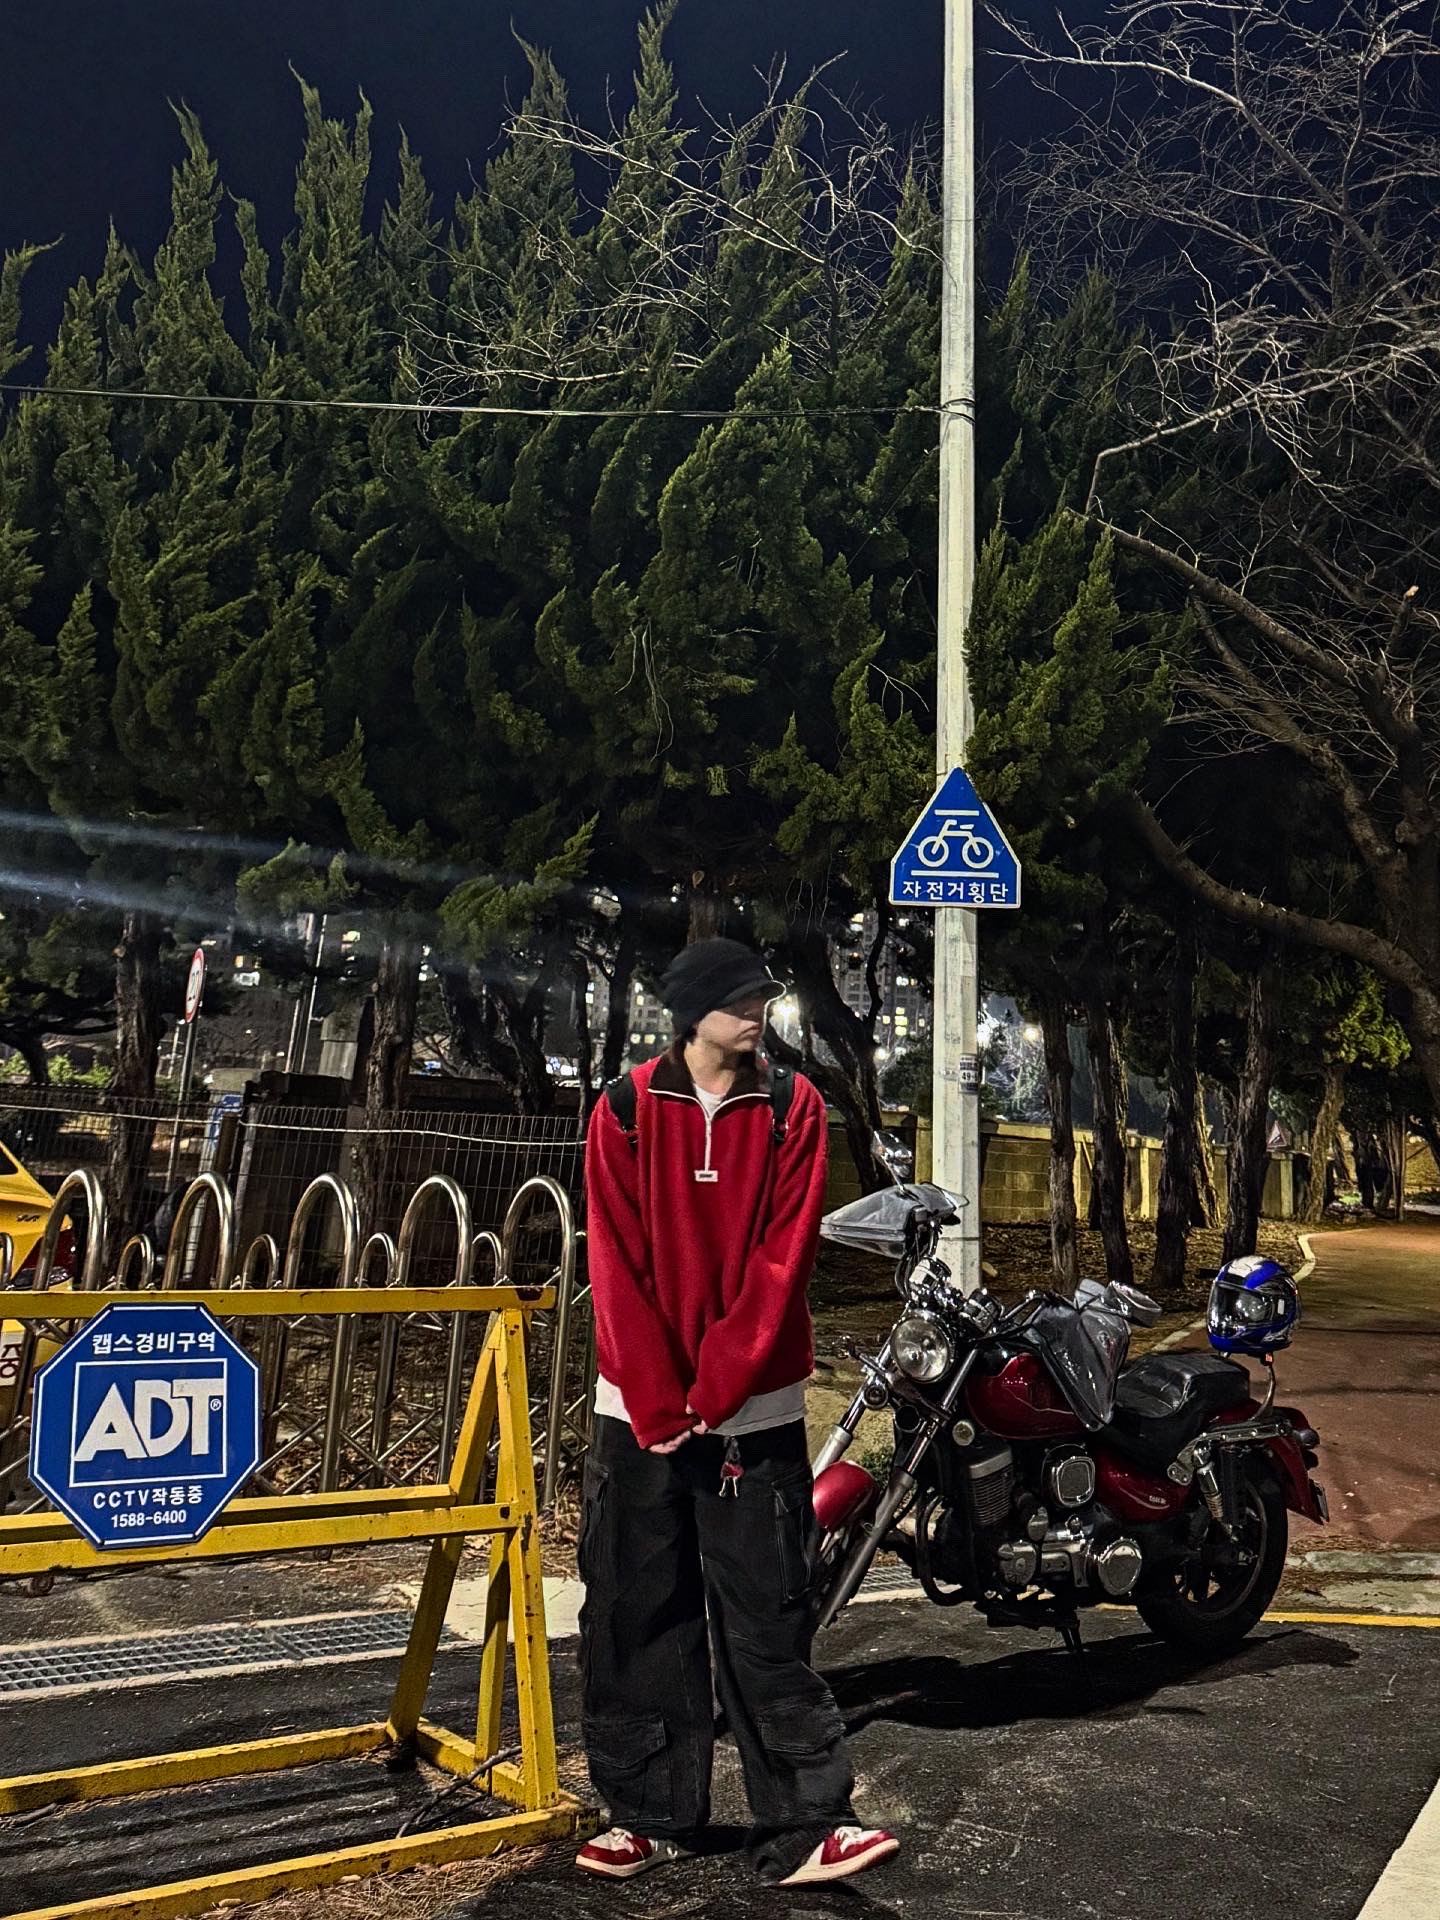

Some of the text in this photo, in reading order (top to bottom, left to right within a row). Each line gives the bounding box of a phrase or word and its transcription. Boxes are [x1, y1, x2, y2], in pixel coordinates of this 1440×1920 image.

[902, 881, 1009, 903] 자전거횡단
[92, 1332, 215, 1355] 캡스경비구역
[74, 1379, 224, 1462] ADT
[93, 1486, 204, 1509] CCTV작동중
[111, 1510, 187, 1528] 1588-6400
